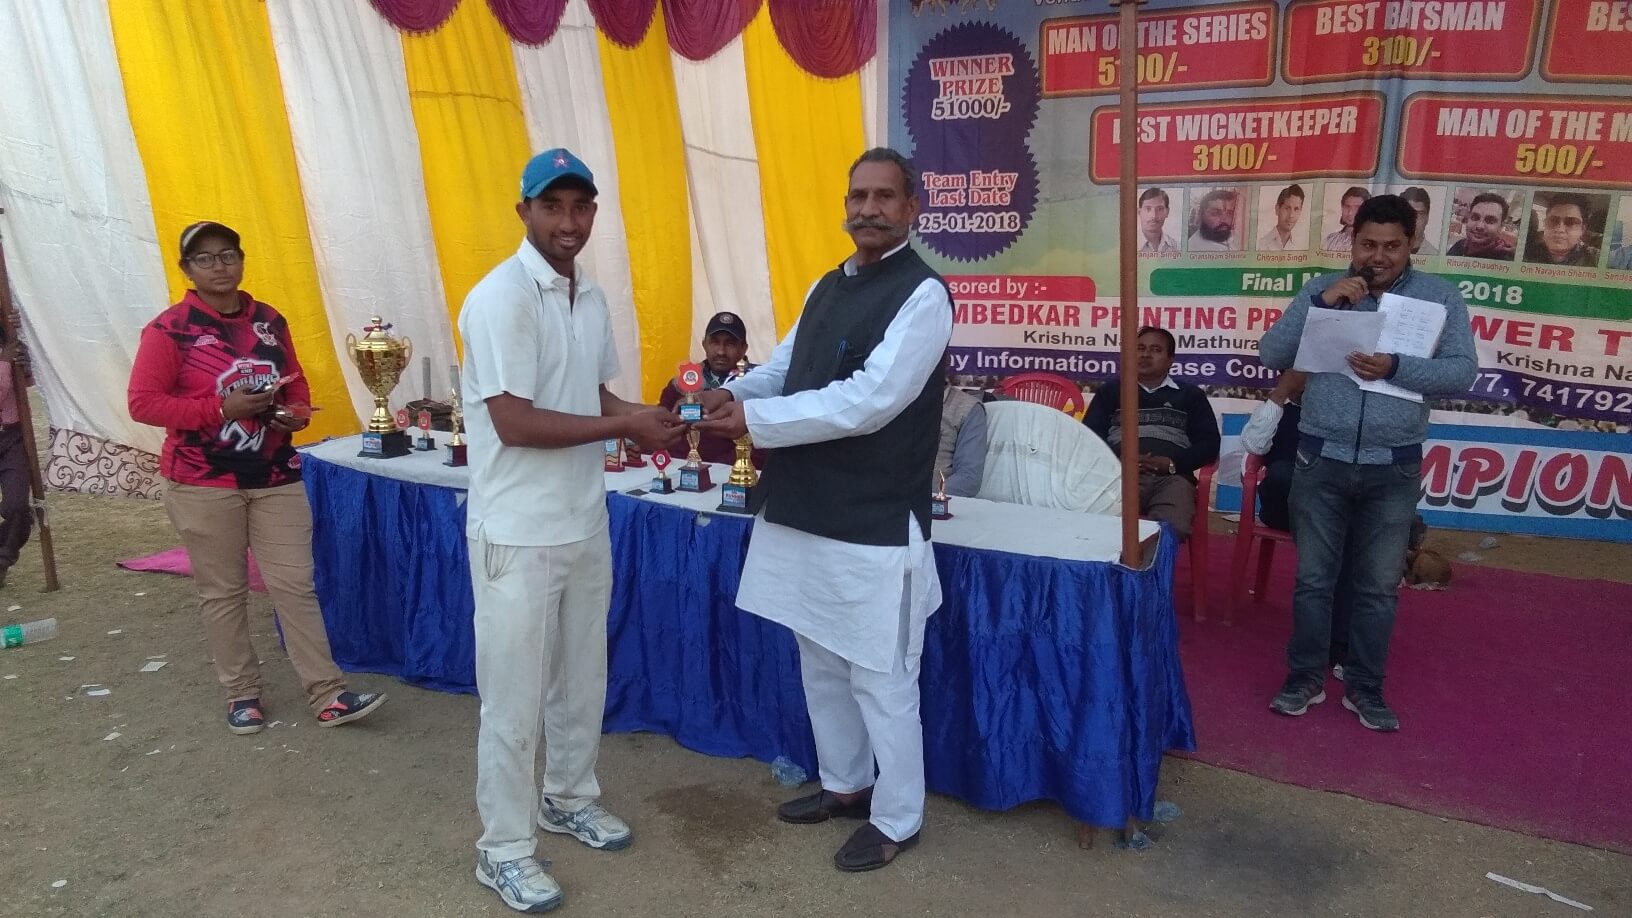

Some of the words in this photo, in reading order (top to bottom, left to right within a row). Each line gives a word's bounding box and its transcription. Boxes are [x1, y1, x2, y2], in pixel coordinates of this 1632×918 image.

[1316, 2, 1380, 35] BEST
[1384, 0, 1506, 31] BATSMAN
[1049, 26, 1096, 54] MAN
[1102, 24, 1120, 51] O
[1137, 20, 1177, 48] THE
[1183, 12, 1268, 44] SERIES
[1362, 35, 1441, 66] 3100/-
[930, 55, 1013, 79] WINNER
[942, 78, 1000, 97] PRIZE
[933, 98, 1009, 118] 51000/-
[1176, 106, 1358, 141] WICKETKEEPER
[1437, 108, 1500, 137] MAN
[1505, 109, 1543, 138] OF
[1550, 111, 1605, 141] THE
[1609, 113, 1632, 142] M
[1193, 143, 1277, 171] 3100/-
[1515, 144, 1604, 175] 500/-
[923, 173, 966, 188] Team
[970, 171, 1017, 190] Entry
[930, 190, 965, 205] Last
[969, 189, 1009, 205] Date
[919, 213, 1019, 232] 25-01-2018
[949, 278, 1000, 294] sored
[1006, 278, 1028, 298] by
[1242, 272, 1293, 291] Final
[1458, 280, 1523, 305] 2018
[954, 303, 1081, 328] MBEDKAR
[1023, 330, 1096, 346] Krishna
[1178, 334, 1259, 350] Mathura
[1497, 350, 1595, 379] Krishna
[977, 351, 1116, 374] Information
[1169, 359, 1216, 376] ase
[1521, 378, 1632, 413] 741792
